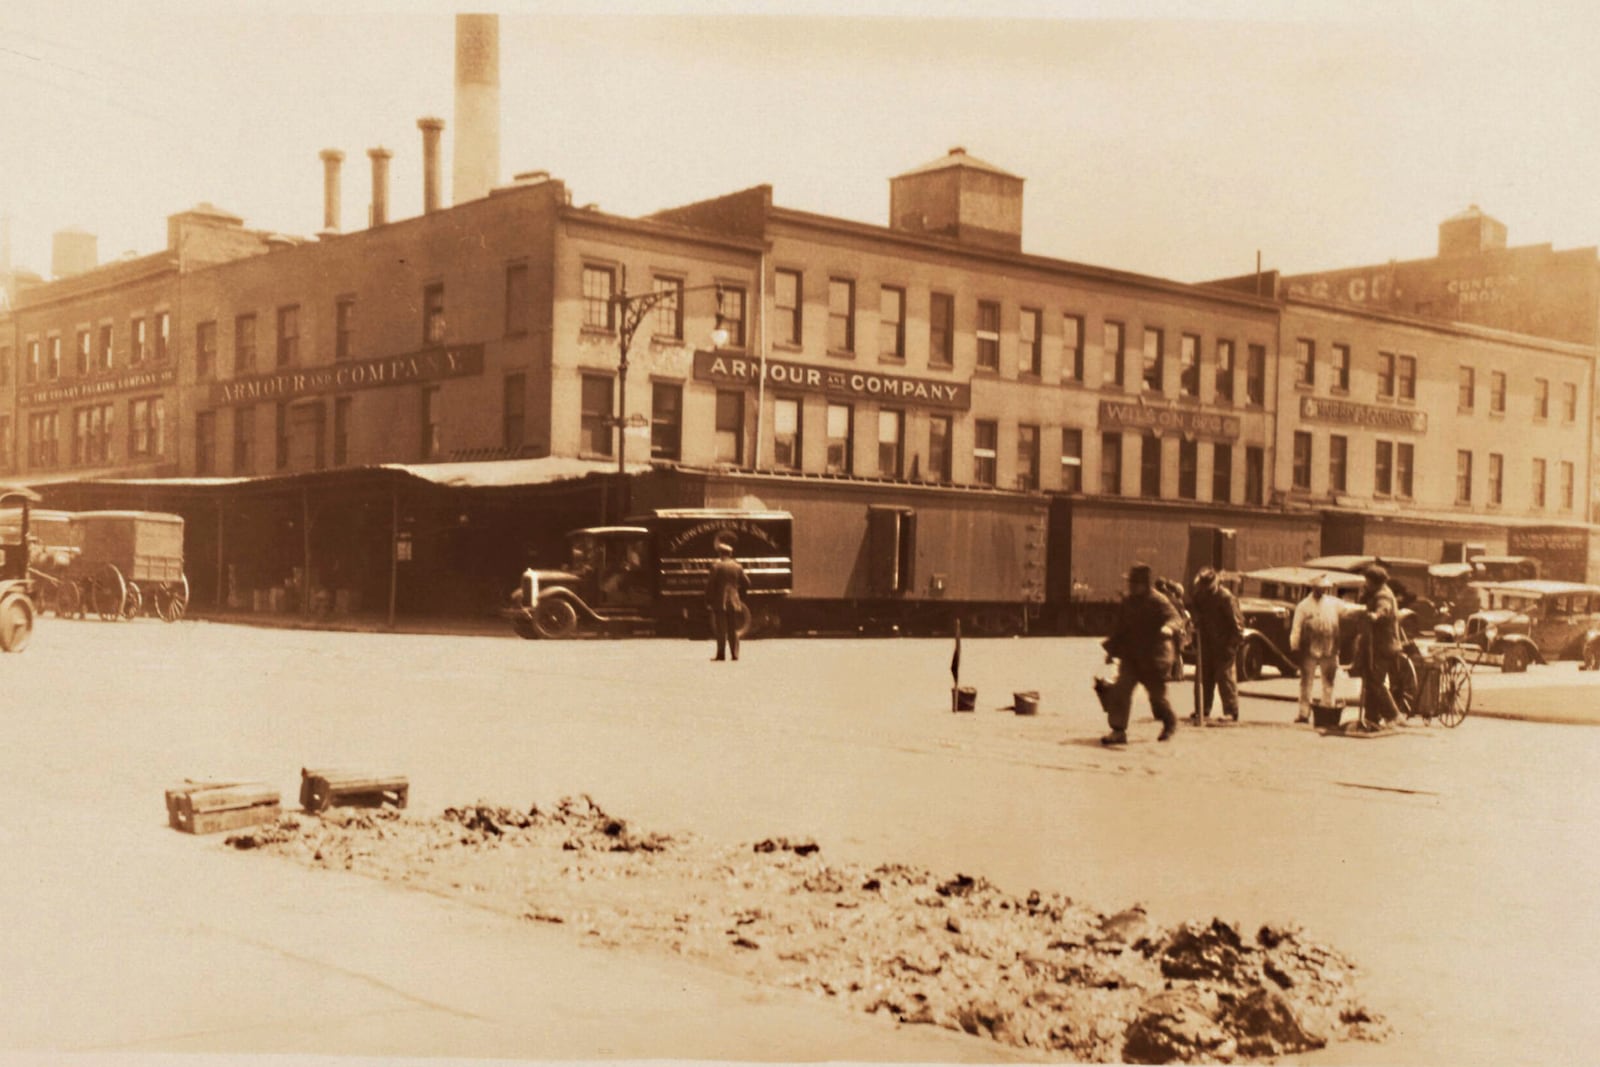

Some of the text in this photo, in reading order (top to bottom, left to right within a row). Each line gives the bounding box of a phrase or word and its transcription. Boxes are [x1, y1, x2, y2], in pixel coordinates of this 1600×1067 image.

[118, 373, 156, 389] COMPANY
[222, 351, 461, 403] ARMOUR AND COMPANY
[710, 357, 958, 400] ARMOUR AND COMPANY
[1107, 402, 1184, 428] WILSON
